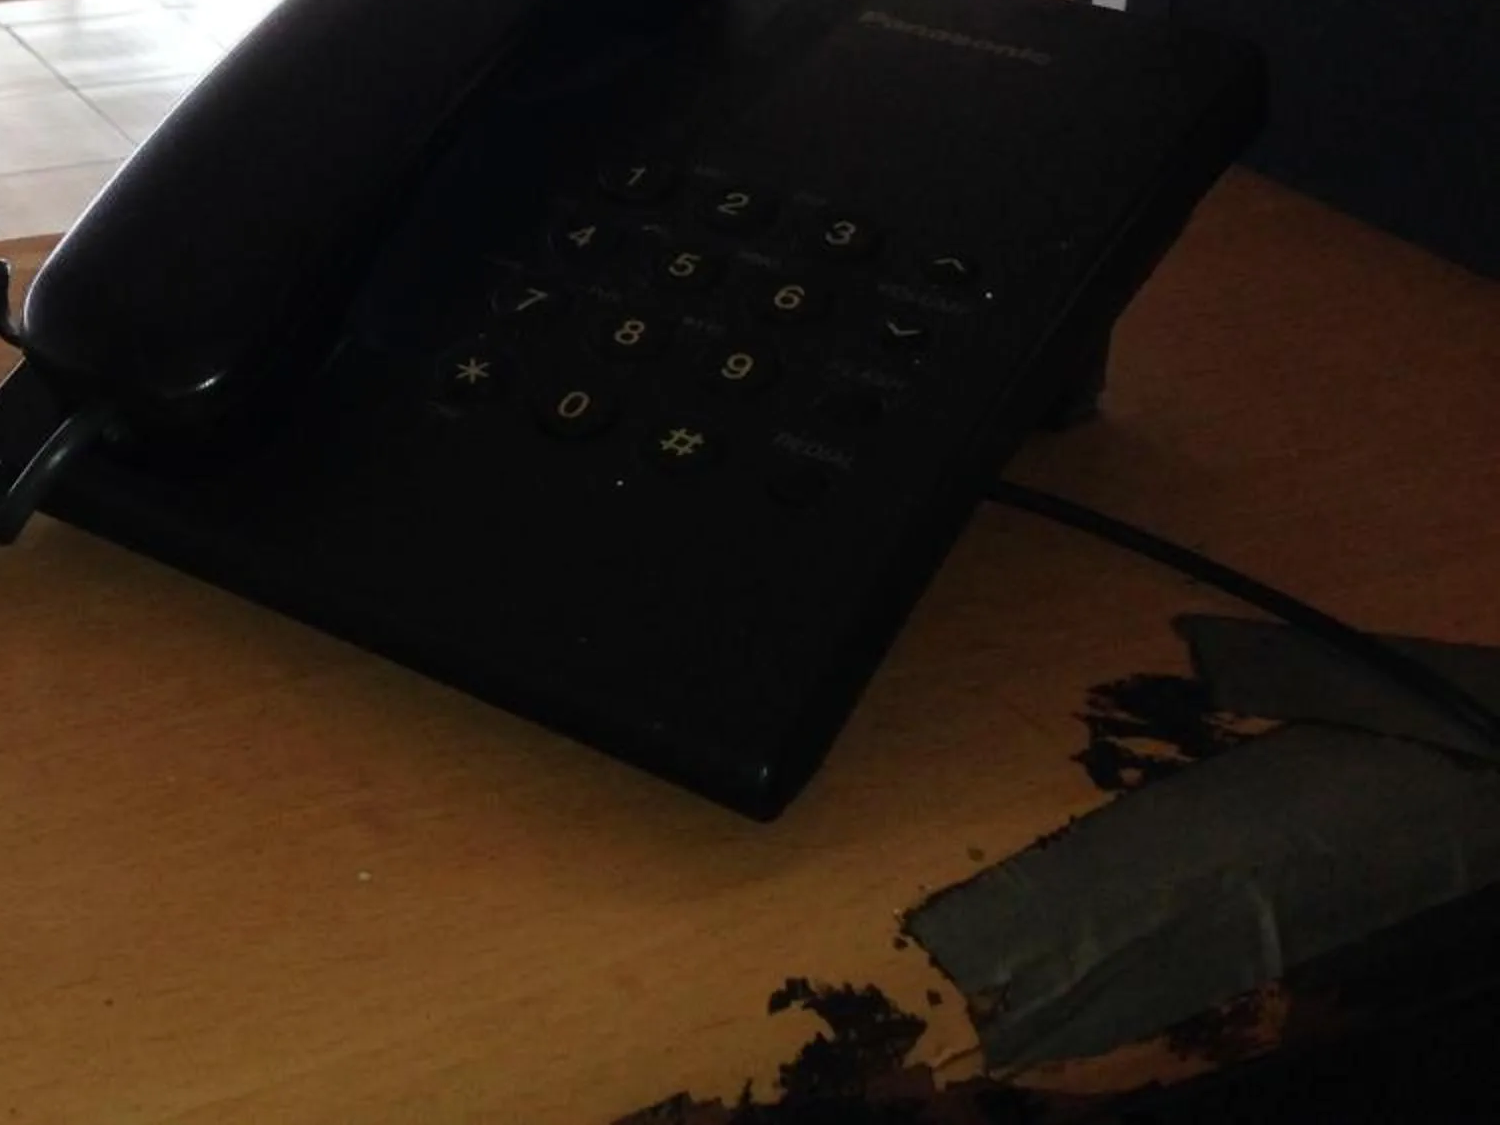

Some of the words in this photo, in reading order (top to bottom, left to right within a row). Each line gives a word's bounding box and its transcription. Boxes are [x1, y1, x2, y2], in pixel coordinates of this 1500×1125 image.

[625, 166, 648, 187] 1
[716, 192, 749, 216] 2
[824, 220, 856, 246] 3
[567, 225, 597, 249] 4
[668, 252, 702, 277] 5
[774, 284, 806, 310] 6
[514, 287, 549, 311] 7
[614, 320, 646, 346] 8
[721, 353, 755, 380] 9
[557, 390, 591, 419] 0
[660, 427, 706, 456] #
